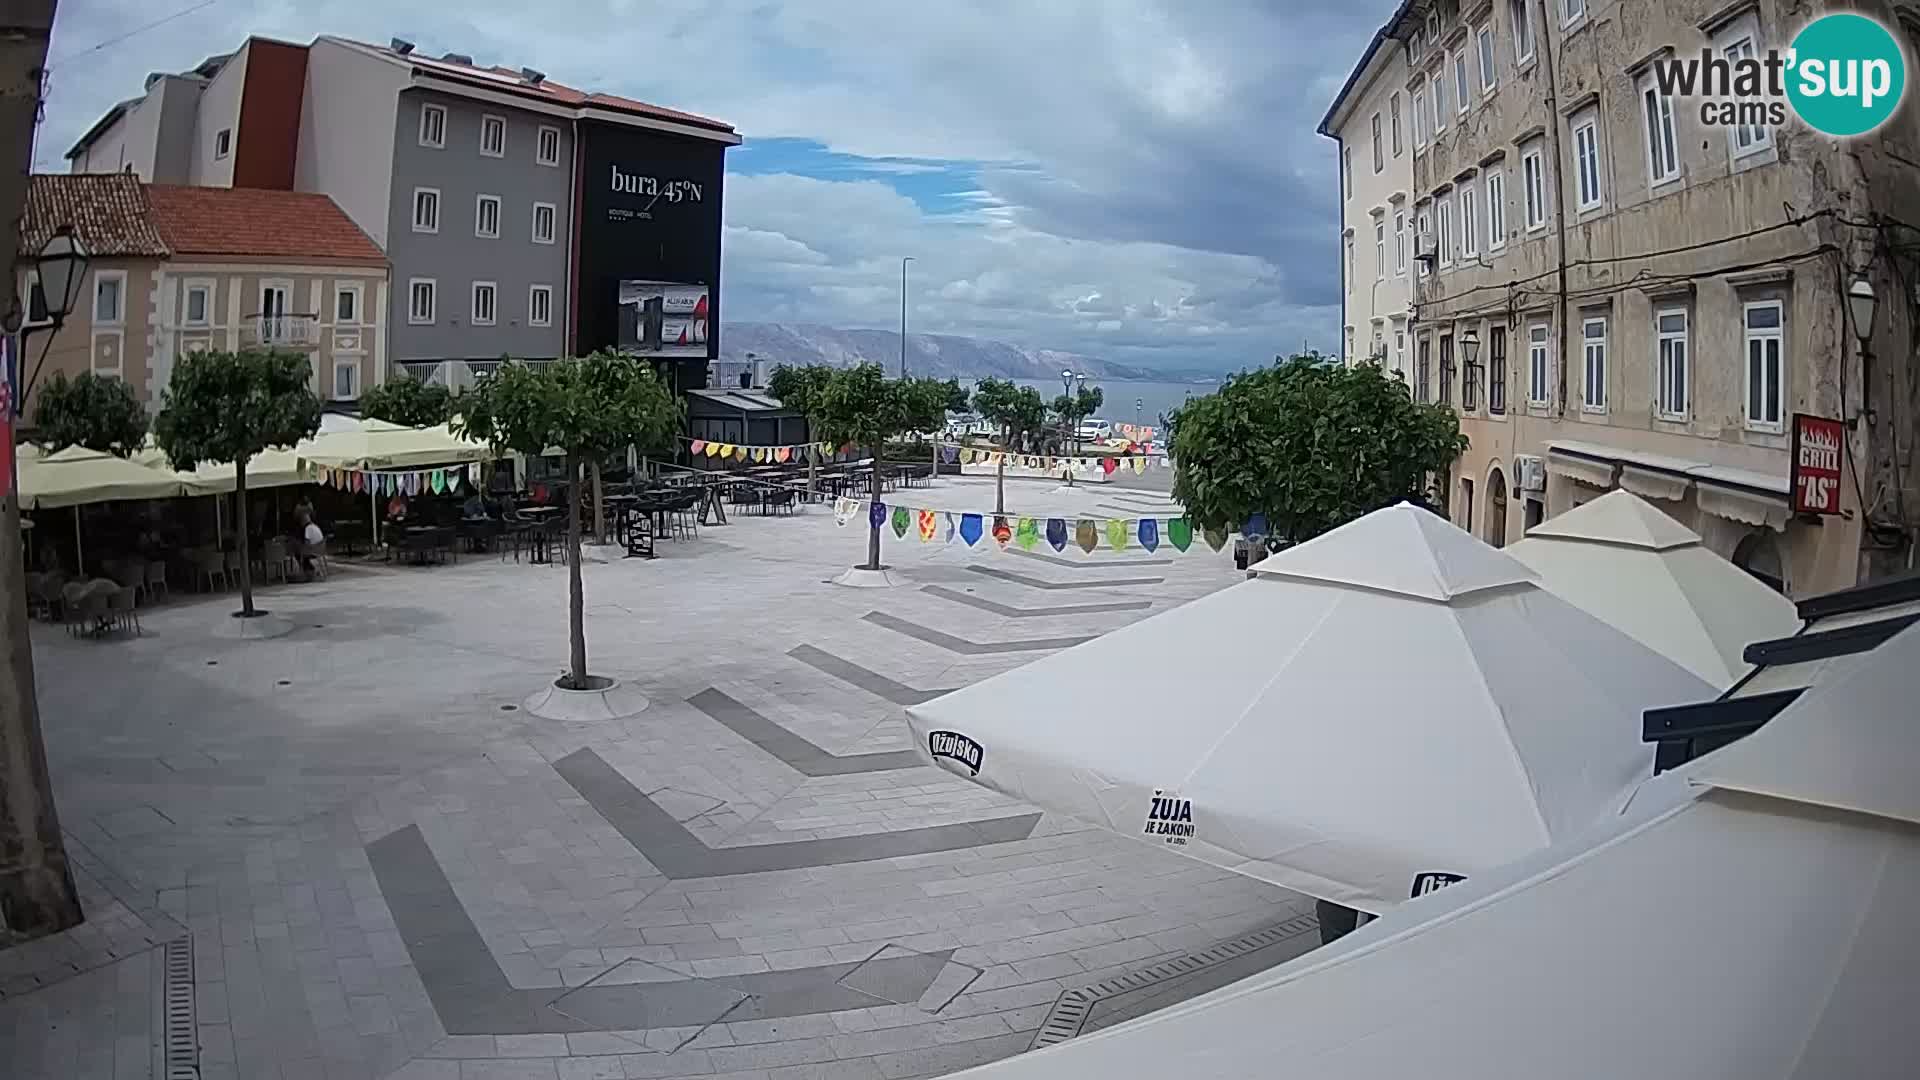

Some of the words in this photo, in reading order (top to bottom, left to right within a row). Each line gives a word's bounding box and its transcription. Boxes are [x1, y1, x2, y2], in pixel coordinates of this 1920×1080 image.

[611, 165, 657, 196] bura
[1799, 447, 1839, 471] GRILL
[932, 733, 979, 766] Ožujsko
[1149, 790, 1192, 823] ŽUJA
[1144, 821, 1156, 834] JE
[1156, 822, 1195, 838] ZAKON!
